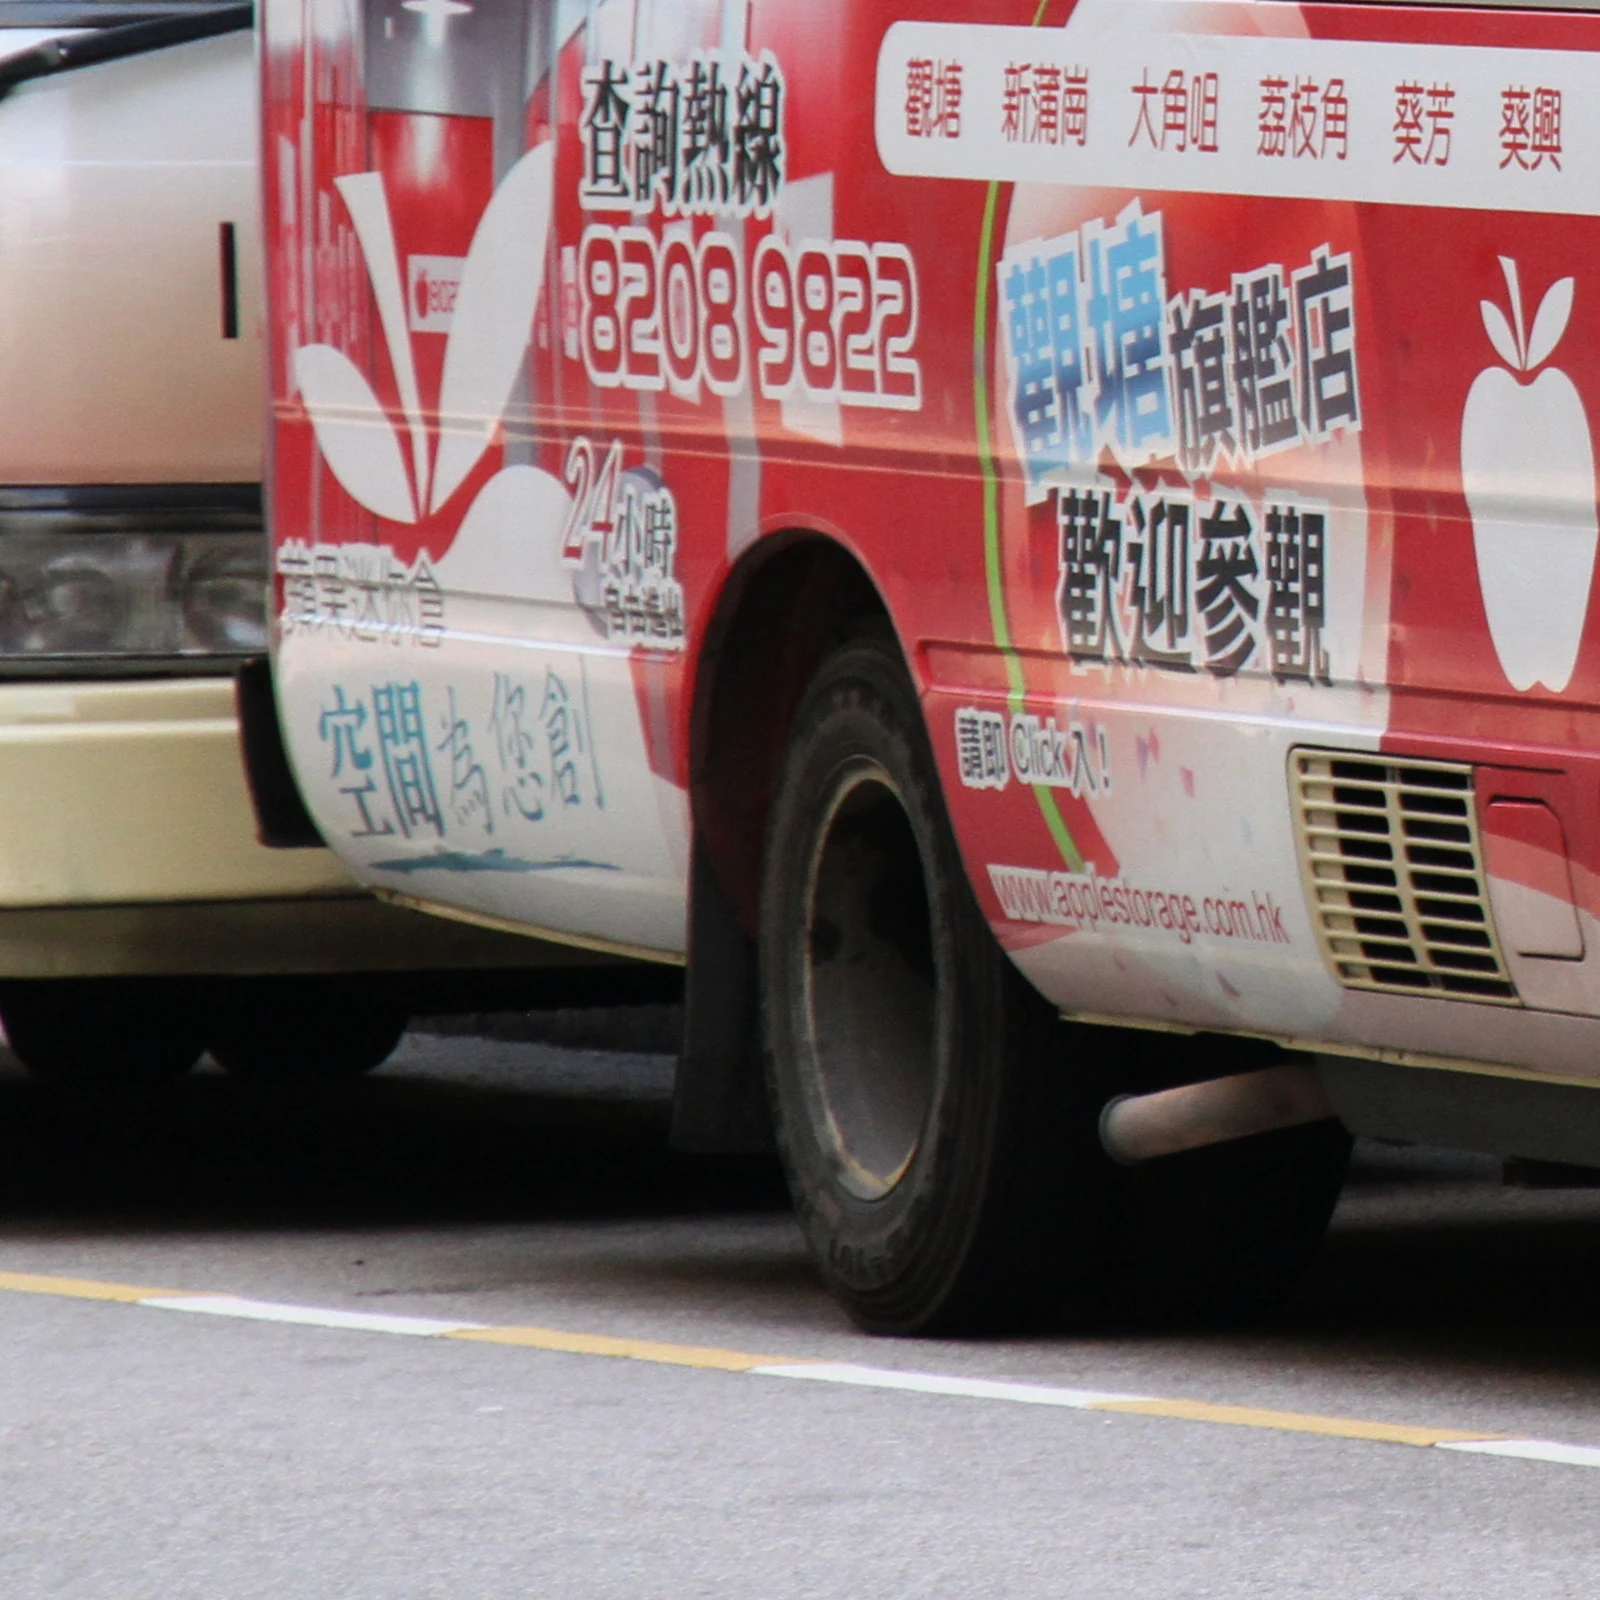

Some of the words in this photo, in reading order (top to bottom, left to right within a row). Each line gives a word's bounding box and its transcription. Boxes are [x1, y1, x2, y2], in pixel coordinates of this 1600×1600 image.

[584, 59, 784, 204] 查詢熱線
[904, 56, 964, 143] 觀塘
[1001, 61, 1089, 149] 新蒲崗
[1129, 66, 1220, 155] 大角咀
[1257, 74, 1349, 163] 荔枝角
[1392, 80, 1456, 168] 葵芳
[1499, 85, 1563, 173] 葵興
[581, 229, 743, 390] 8208
[754, 241, 919, 405] 9822
[988, 867, 1292, 945] www.applestorage.com.hk
